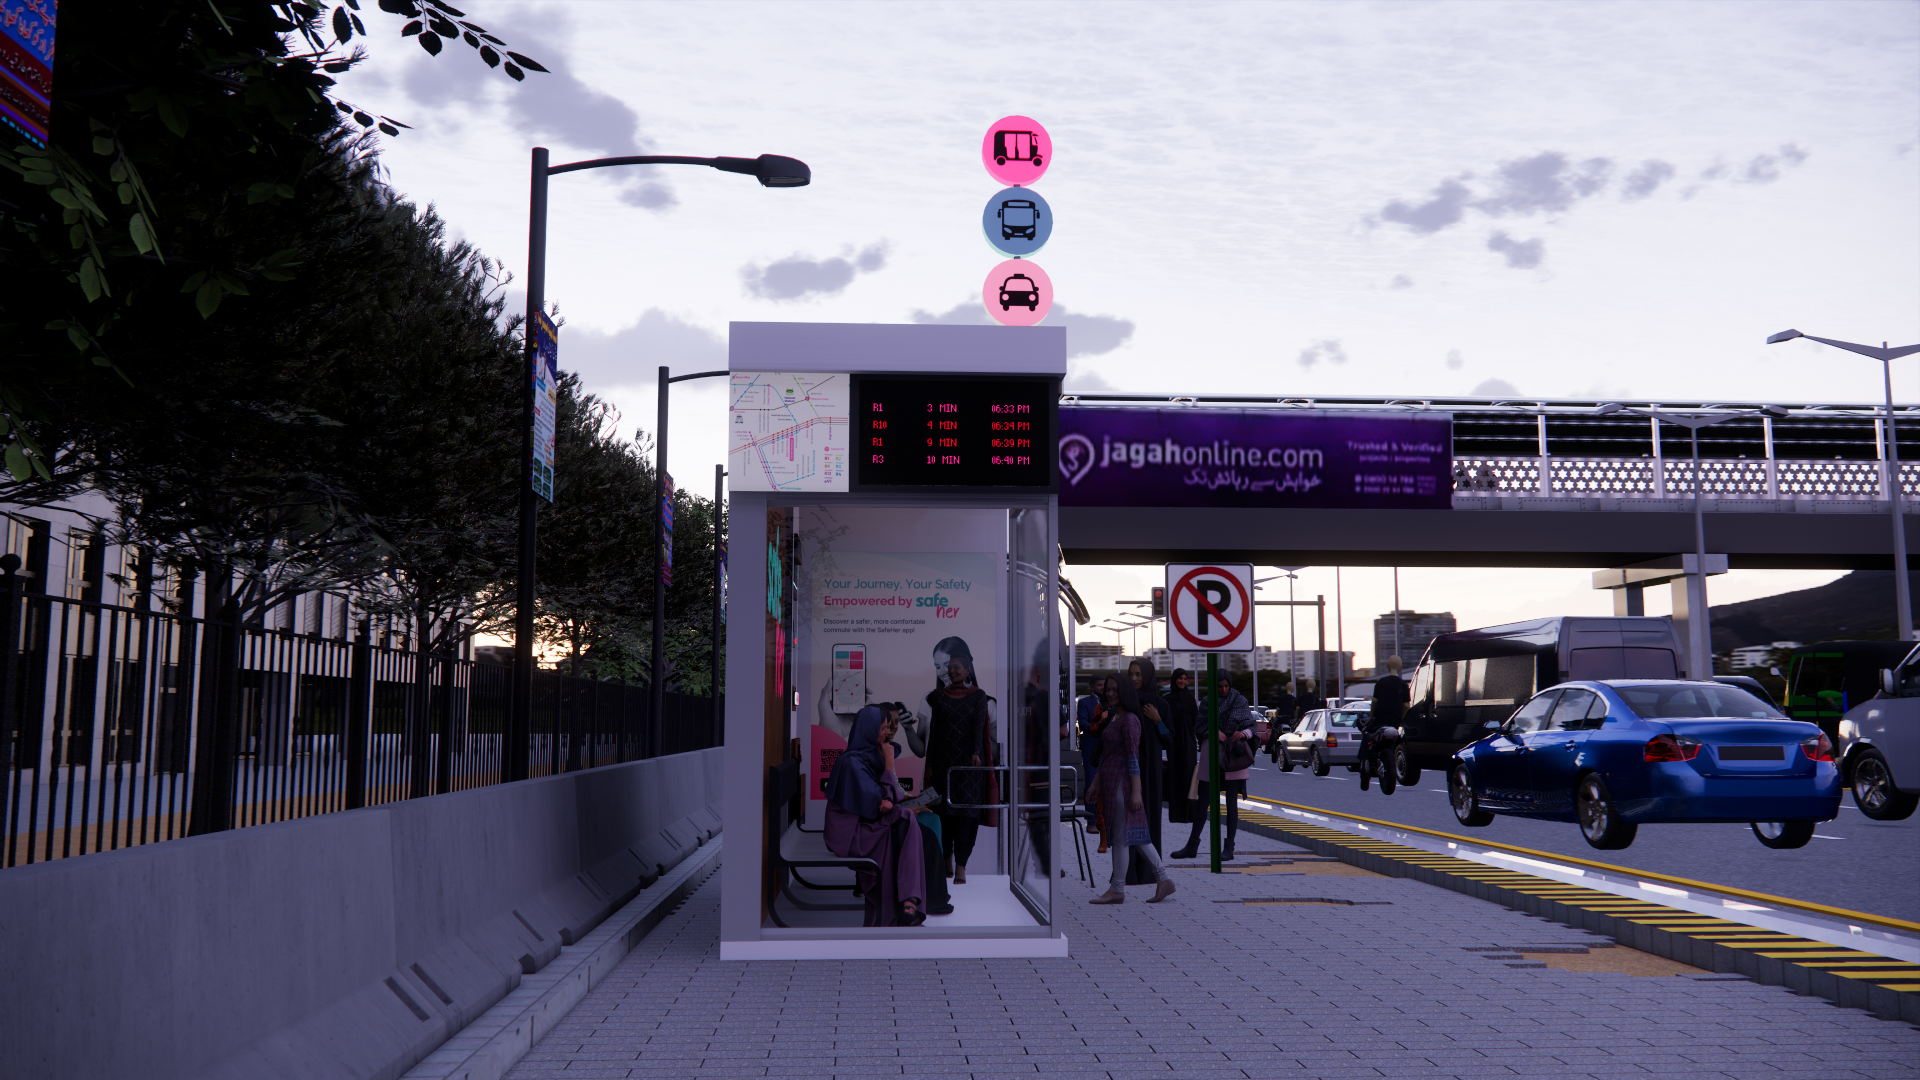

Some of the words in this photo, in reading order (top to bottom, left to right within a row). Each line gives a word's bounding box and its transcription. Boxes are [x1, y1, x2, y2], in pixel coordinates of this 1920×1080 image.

[873, 403, 883, 411] R1
[927, 404, 932, 412] 3
[940, 404, 957, 412] MIN
[992, 405, 1014, 413] 06:33
[1017, 405, 1030, 413] PM
[873, 420, 887, 429] R10
[927, 421, 932, 429] 4
[940, 421, 957, 429] MIN
[992, 422, 1014, 430] 06:34
[1017, 422, 1030, 430] PM
[873, 438, 883, 446] R1
[927, 438, 932, 446] 9
[940, 438, 957, 446] MIN
[992, 439, 1014, 447] 06:39
[1017, 439, 1030, 447] PM
[1100, 435, 1323, 469] jagahonline.com
[873, 455, 884, 463] R3
[927, 456, 935, 464] 10
[942, 456, 960, 464] MIN
[992, 456, 1013, 464] 06:40
[1017, 456, 1030, 464] PM
[824, 579, 851, 589] Your
[853, 578, 903, 592] Journey,
[906, 579, 933, 589] Your
[935, 579, 972, 592] Safety
[824, 596, 895, 608] Empowered
[898, 595, 912, 608] by
[916, 593, 948, 607] safe
[1197, 580, 1231, 635] P
[936, 604, 960, 619] her
